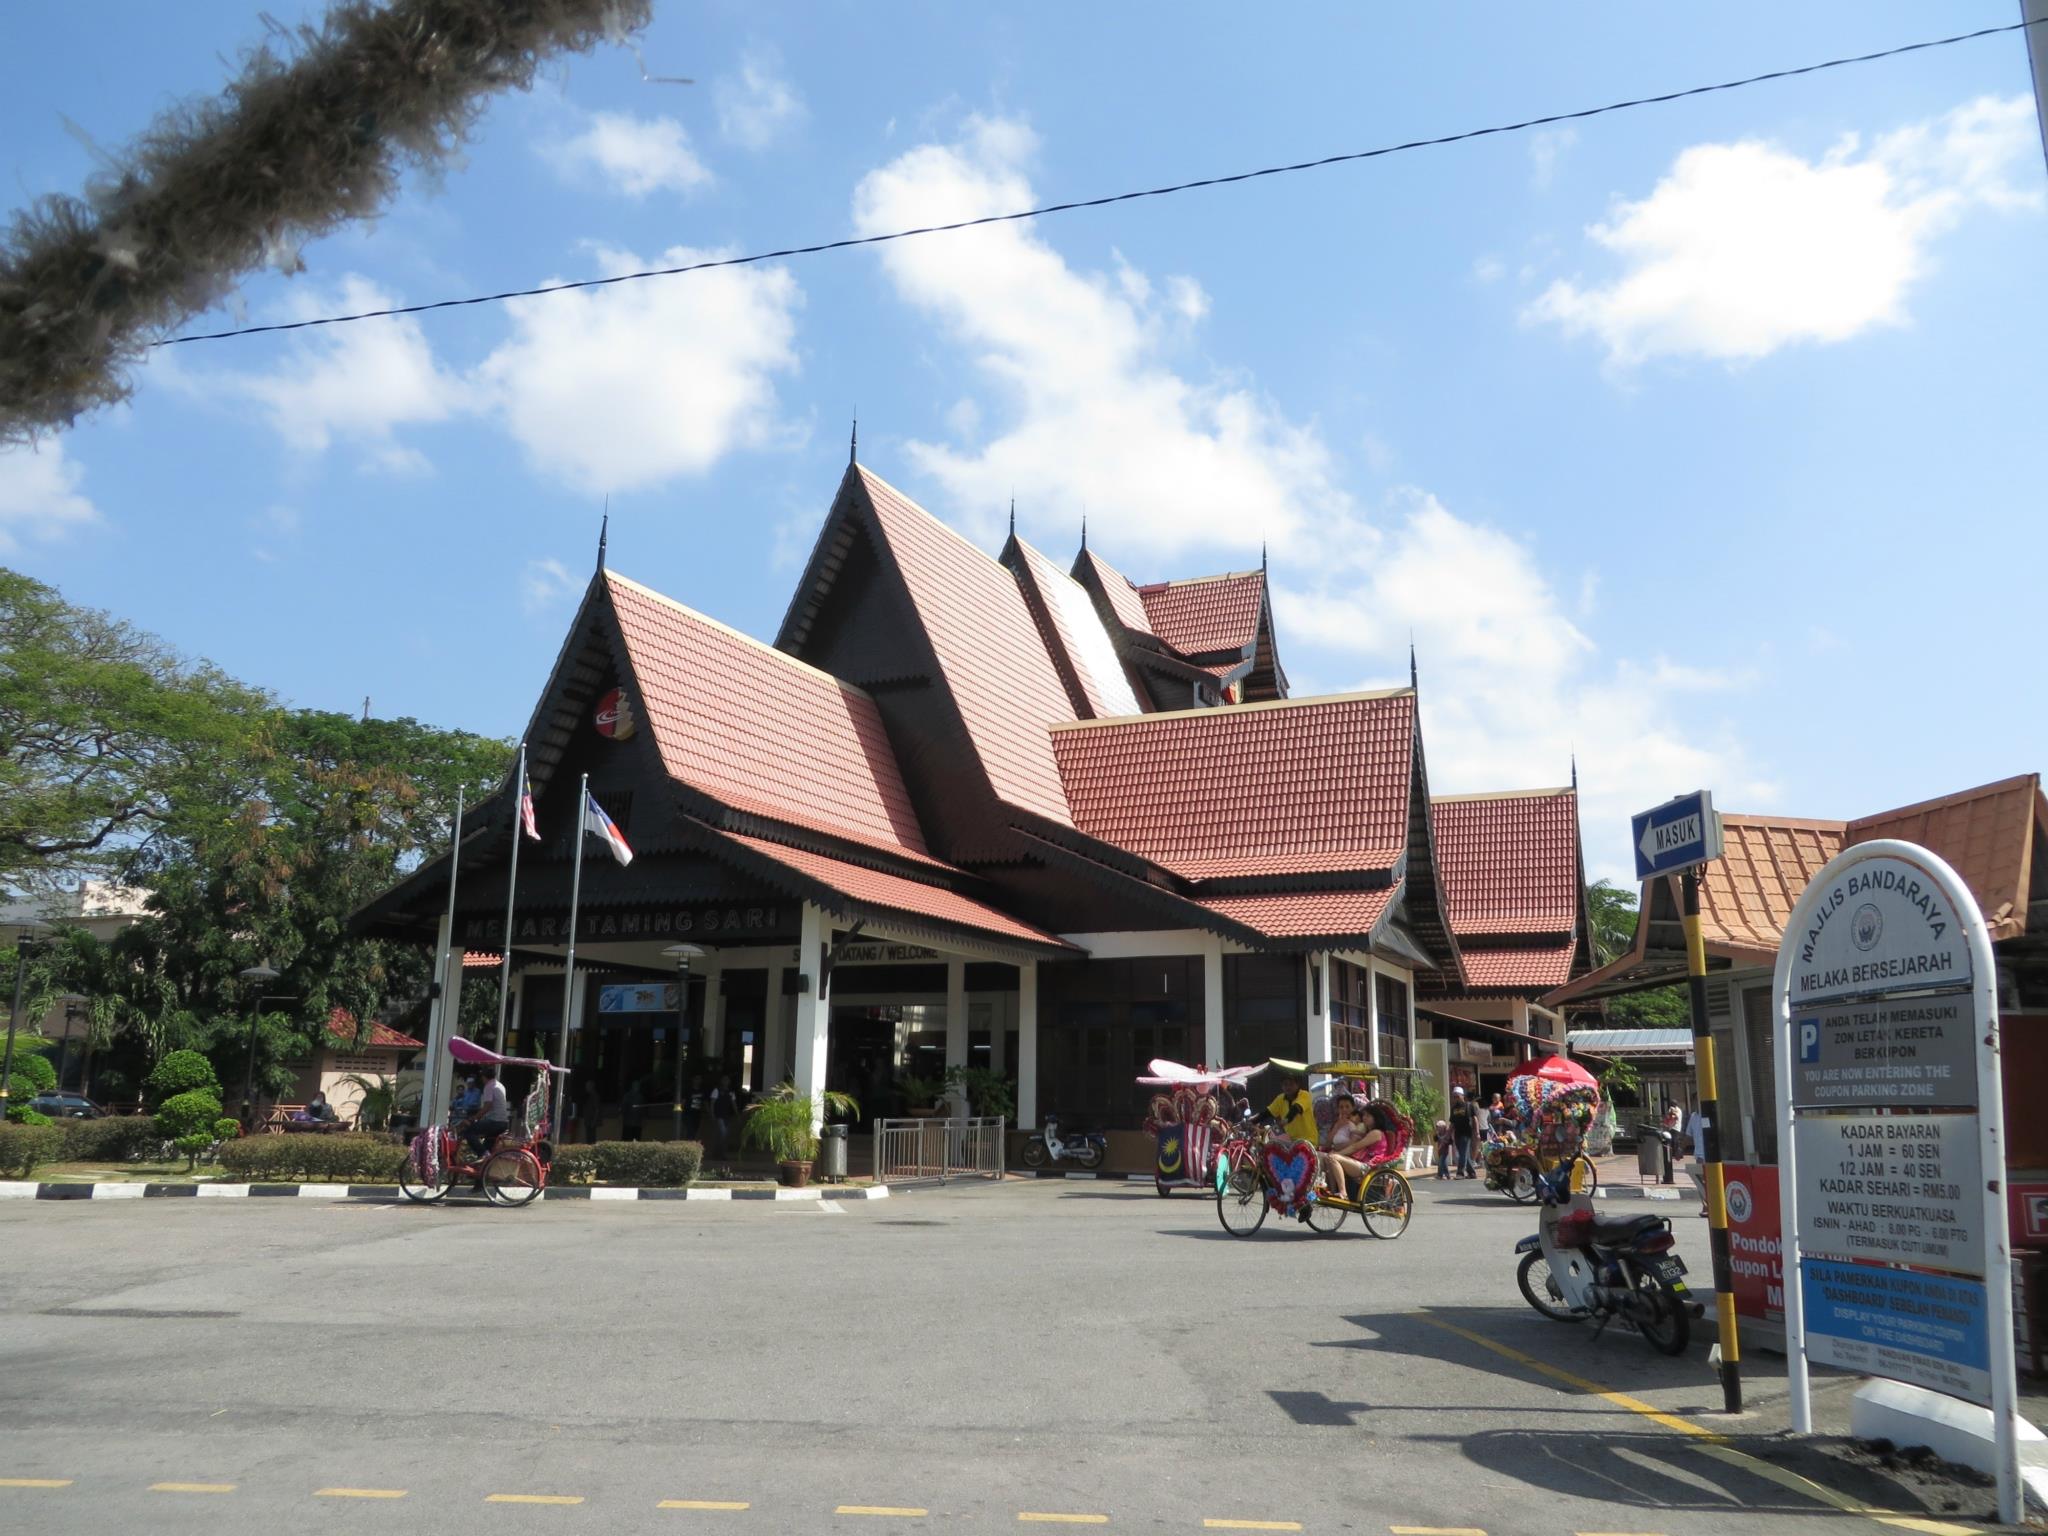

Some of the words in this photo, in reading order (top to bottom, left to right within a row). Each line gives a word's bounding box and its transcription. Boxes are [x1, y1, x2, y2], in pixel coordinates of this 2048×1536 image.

[1656, 818, 1696, 850] MASUK
[586, 910, 693, 936] TAMING
[704, 907, 777, 930] SARI
[1802, 888, 1845, 963] MAJLIS
[1848, 870, 1947, 940] BANDARAYA
[887, 945, 938, 960] WELCOME
[1800, 969, 1850, 992] MELAKA
[1852, 952, 1952, 983] BERSEJARAH
[1825, 1018, 1851, 1028] ANDA
[1853, 1012, 1888, 1025] TELAH
[1890, 1006, 1958, 1023] MEMASUKI
[1801, 1024, 1817, 1059] P
[1834, 1032, 1855, 1044] ZON
[1895, 1026, 1944, 1039] KERETA
[1854, 1046, 1917, 1060] BERKUPON
[1805, 1070, 1821, 1082] YOU
[1822, 1068, 1839, 1081] ARE
[1841, 1067, 1862, 1080] NOW
[1865, 1065, 1922, 1079] ENTERING
[1925, 1065, 1951, 1078] THE
[1815, 1085, 1850, 1097] COUPON
[1852, 1084, 1898, 1097] PARKING
[1900, 1083, 1935, 1096] ZONE
[1841, 1125, 1884, 1139] KADAR
[1888, 1124, 1941, 1139] BAYARAN
[1858, 1143, 1883, 1158] JAM
[1902, 1144, 1914, 1158] 60
[1917, 1144, 1940, 1159] SEN
[1839, 1161, 1857, 1175] 1/2
[1859, 1162, 1884, 1176] JAM
[1903, 1164, 1916, 1178] 40
[1919, 1164, 1941, 1179] SEN
[1820, 1179, 1864, 1194] KADAR
[1867, 1183, 1911, 1198] SEHARI
[1923, 1184, 1960, 1200] RM5.00
[1828, 1201, 1868, 1216] WAKTU
[1872, 1204, 1957, 1223] BERKUATKUASA
[1814, 1217, 1840, 1230] ISNIN
[1848, 1220, 1876, 1233] AHAD
[1846, 1235, 1899, 1250] (TERMASUK
